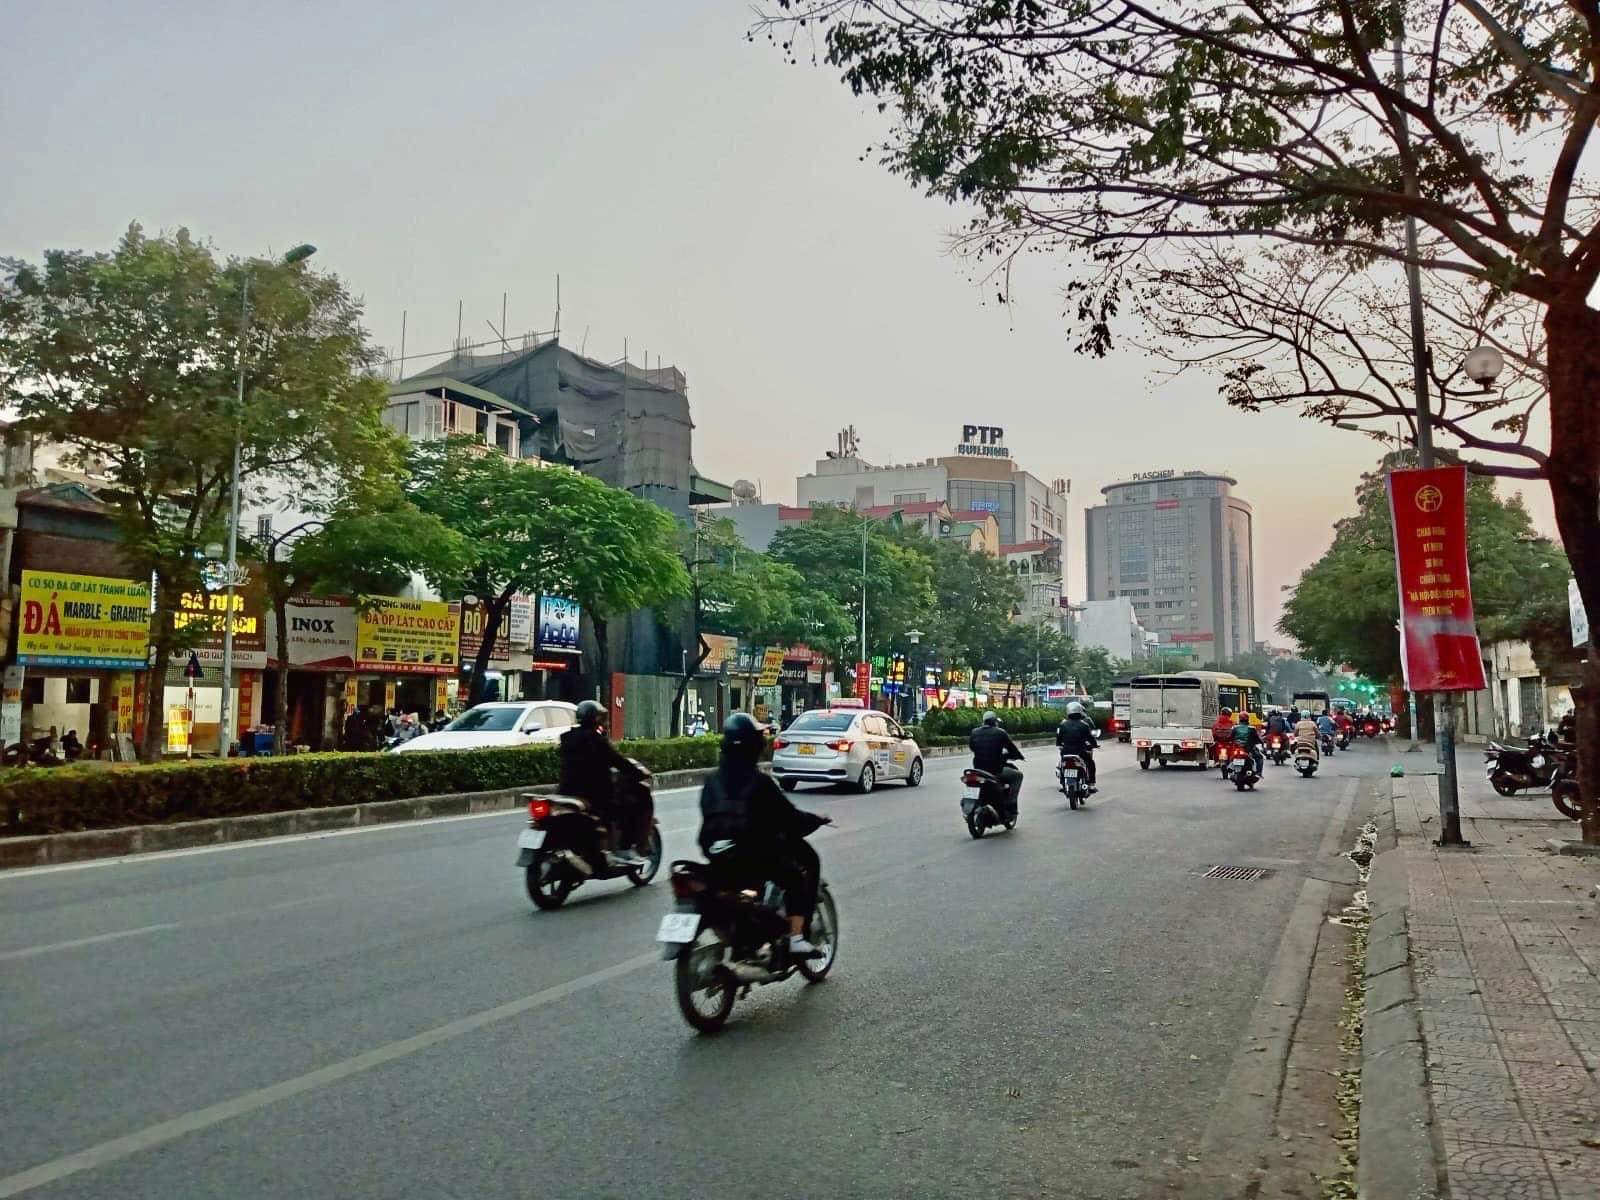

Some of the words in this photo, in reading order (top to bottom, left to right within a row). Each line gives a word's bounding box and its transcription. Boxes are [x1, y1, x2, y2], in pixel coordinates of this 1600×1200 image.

[963, 424, 1004, 445] PTP
[958, 444, 1009, 457] BUILDING
[1132, 469, 1175, 481] PLASCHEM
[23, 592, 62, 635] ĐÁ
[63, 601, 102, 620] MARBLE
[110, 605, 148, 624] GRANITE
[292, 617, 335, 634] INOX
[417, 617, 436, 629] CAO
